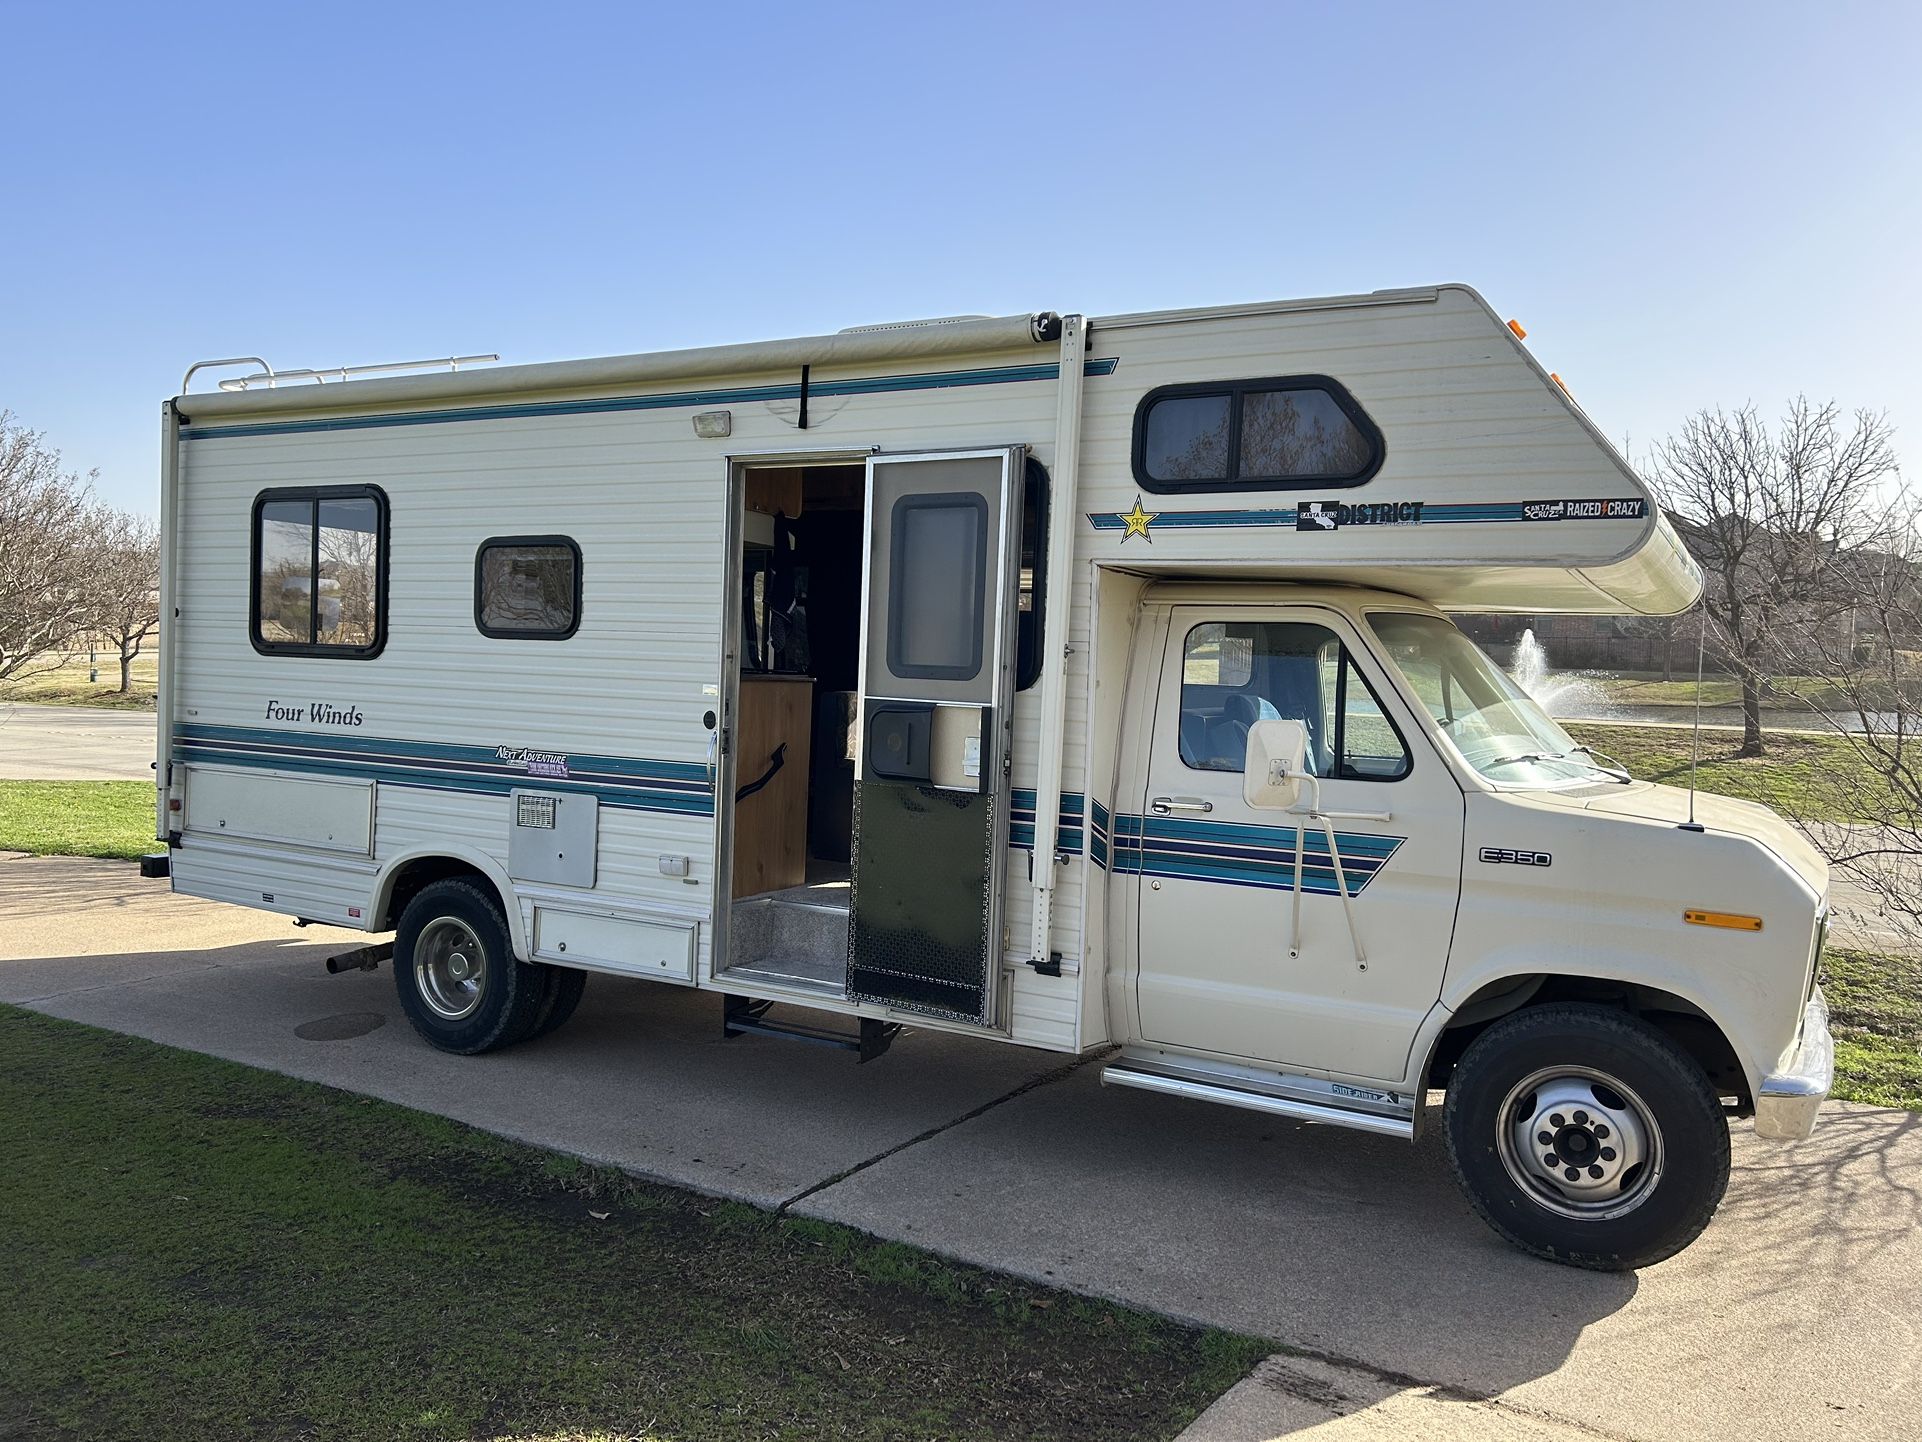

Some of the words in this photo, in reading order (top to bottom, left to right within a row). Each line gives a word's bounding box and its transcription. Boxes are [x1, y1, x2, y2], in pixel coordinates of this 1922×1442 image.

[1300, 511, 1320, 519] SANTA
[1339, 501, 1425, 524] DISTRICT
[1523, 503, 1550, 517] SANTA
[1530, 510, 1559, 519] CRUZ
[1566, 502, 1601, 516] RAIZED
[1607, 501, 1642, 515] CRAZY
[265, 700, 304, 721] Four
[310, 703, 363, 726] Winds
[1333, 1085, 1353, 1096] SIDE
